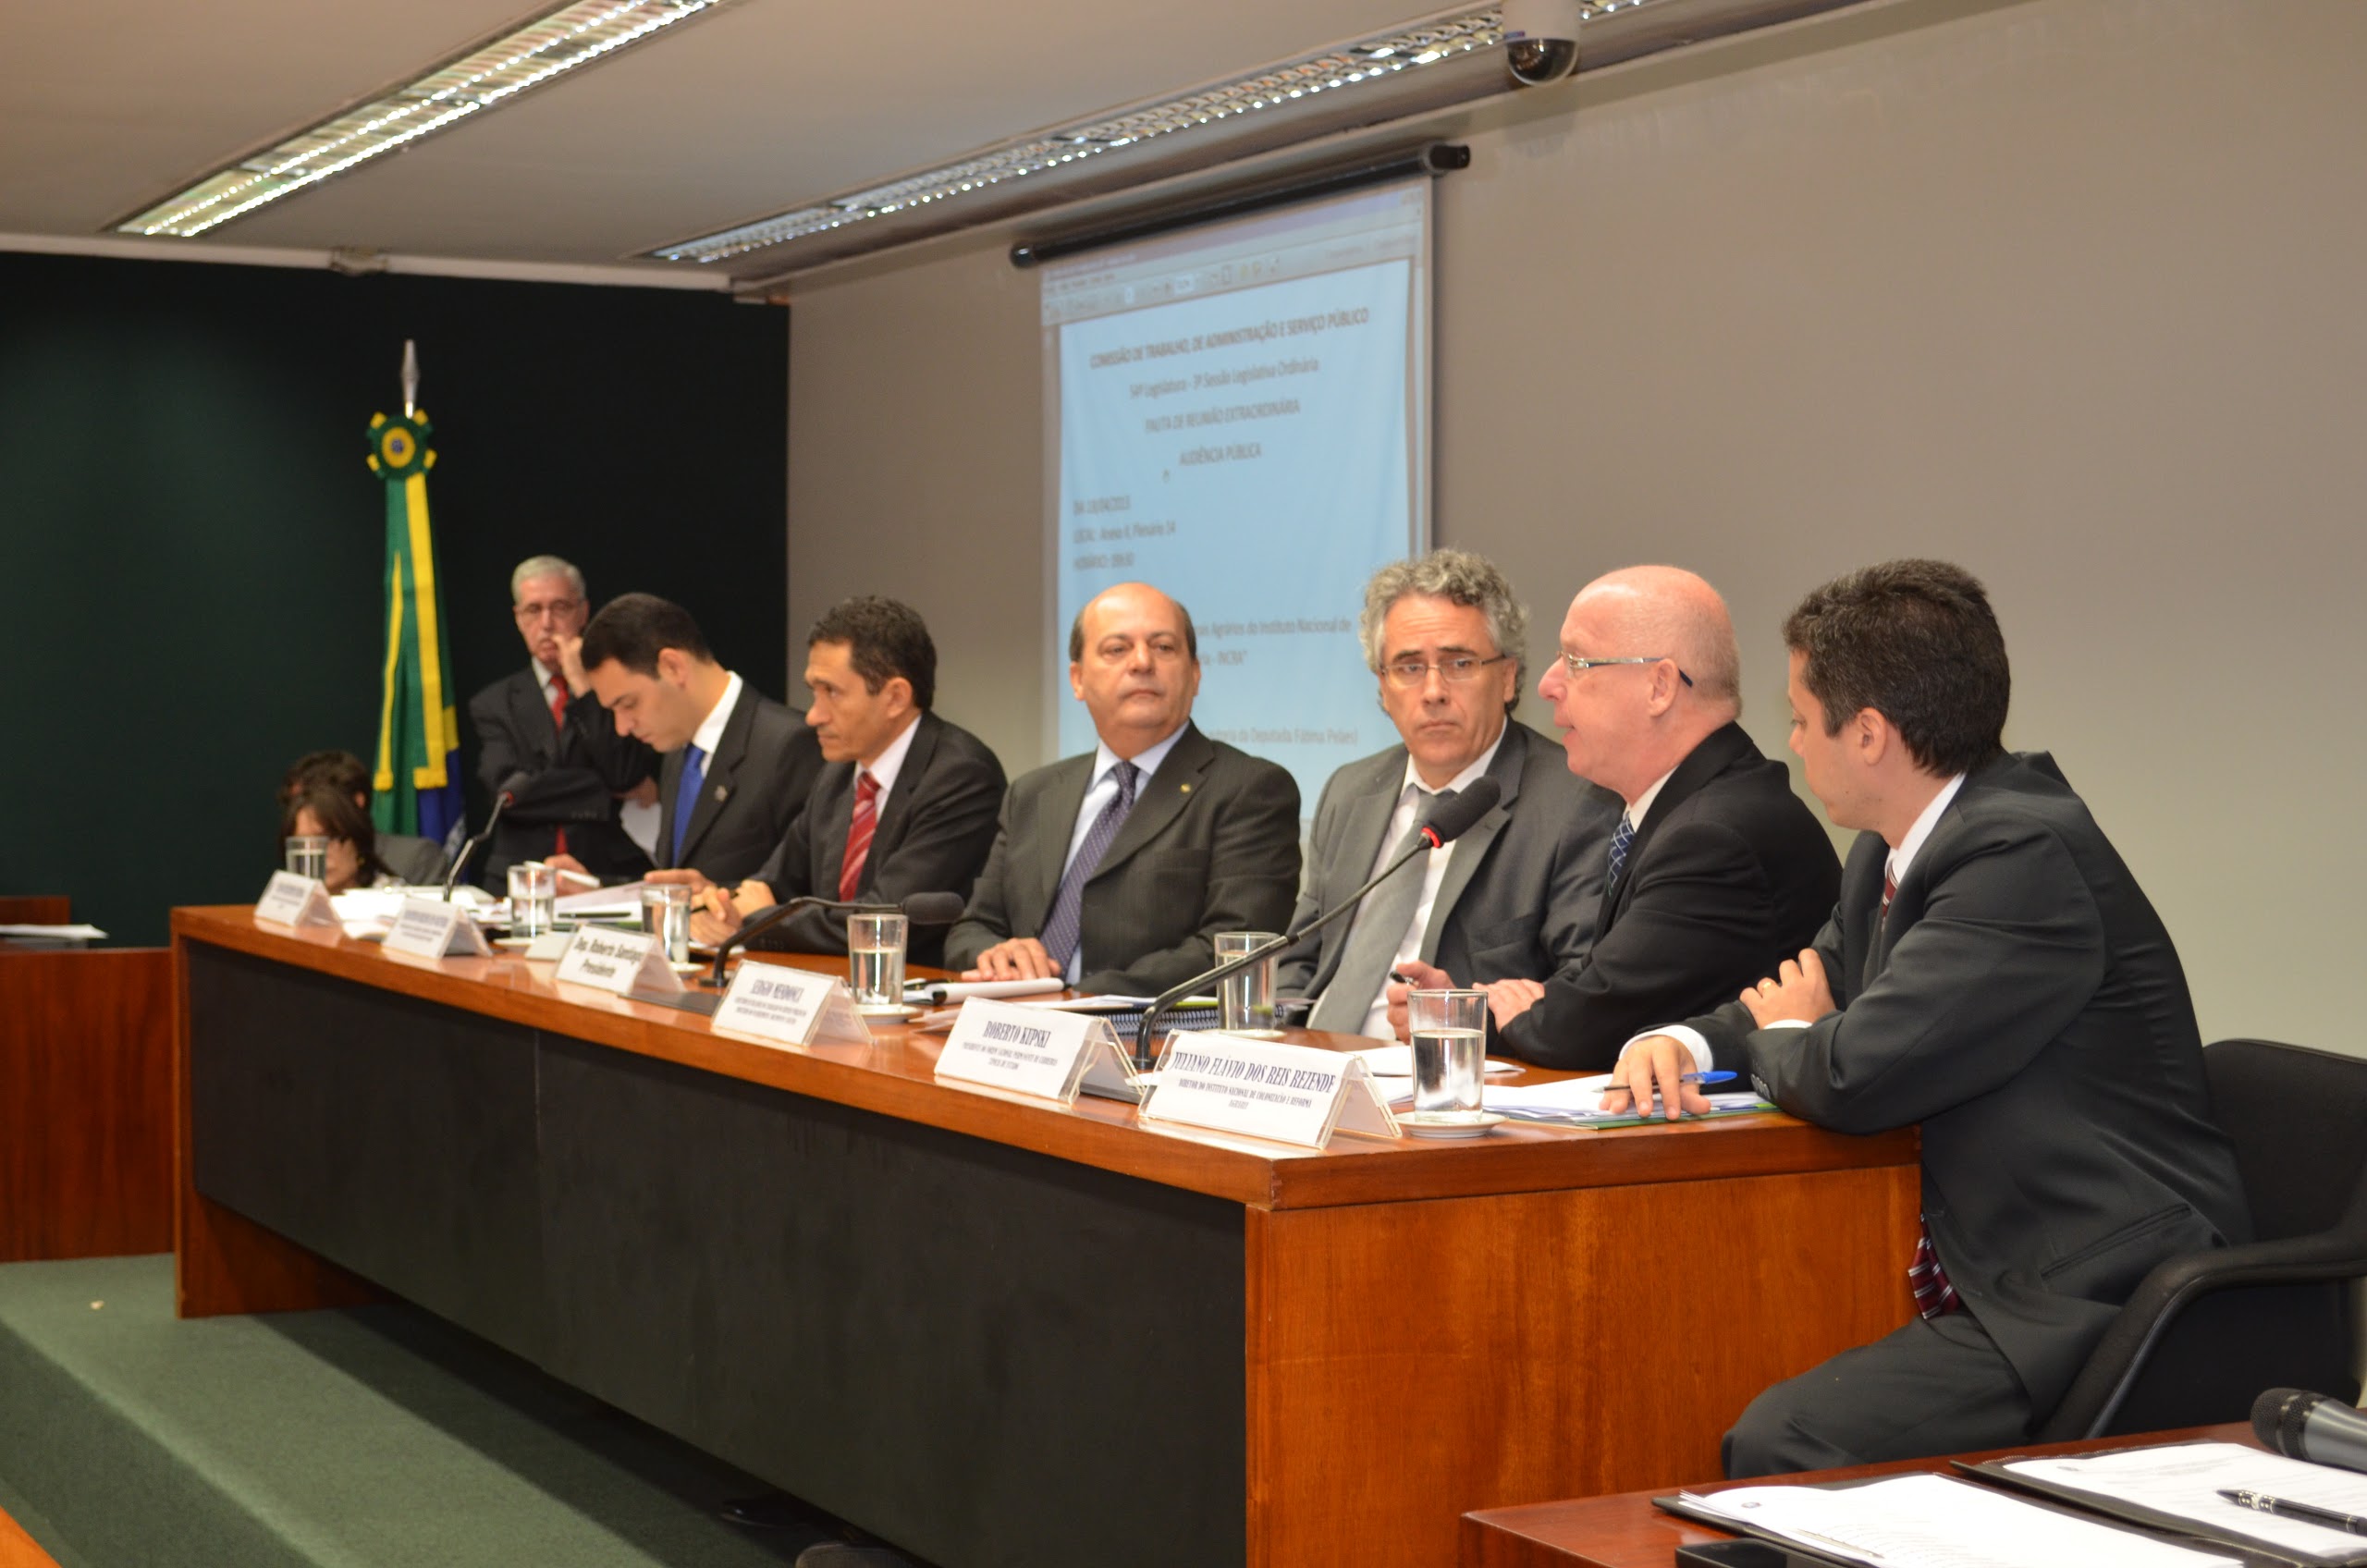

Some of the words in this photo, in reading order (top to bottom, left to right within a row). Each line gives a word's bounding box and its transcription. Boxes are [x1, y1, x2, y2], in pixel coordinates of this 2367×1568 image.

[982, 1020, 1022, 1044] ROBERTO
[1019, 1026, 1051, 1048] KUPSKI
[1168, 1051, 1210, 1073] JULIANO
[1208, 1055, 1245, 1079] FLÁVIO
[1244, 1062, 1268, 1083] DOS
[1265, 1066, 1292, 1087] REIS
[1289, 1070, 1336, 1094] REZENDE
